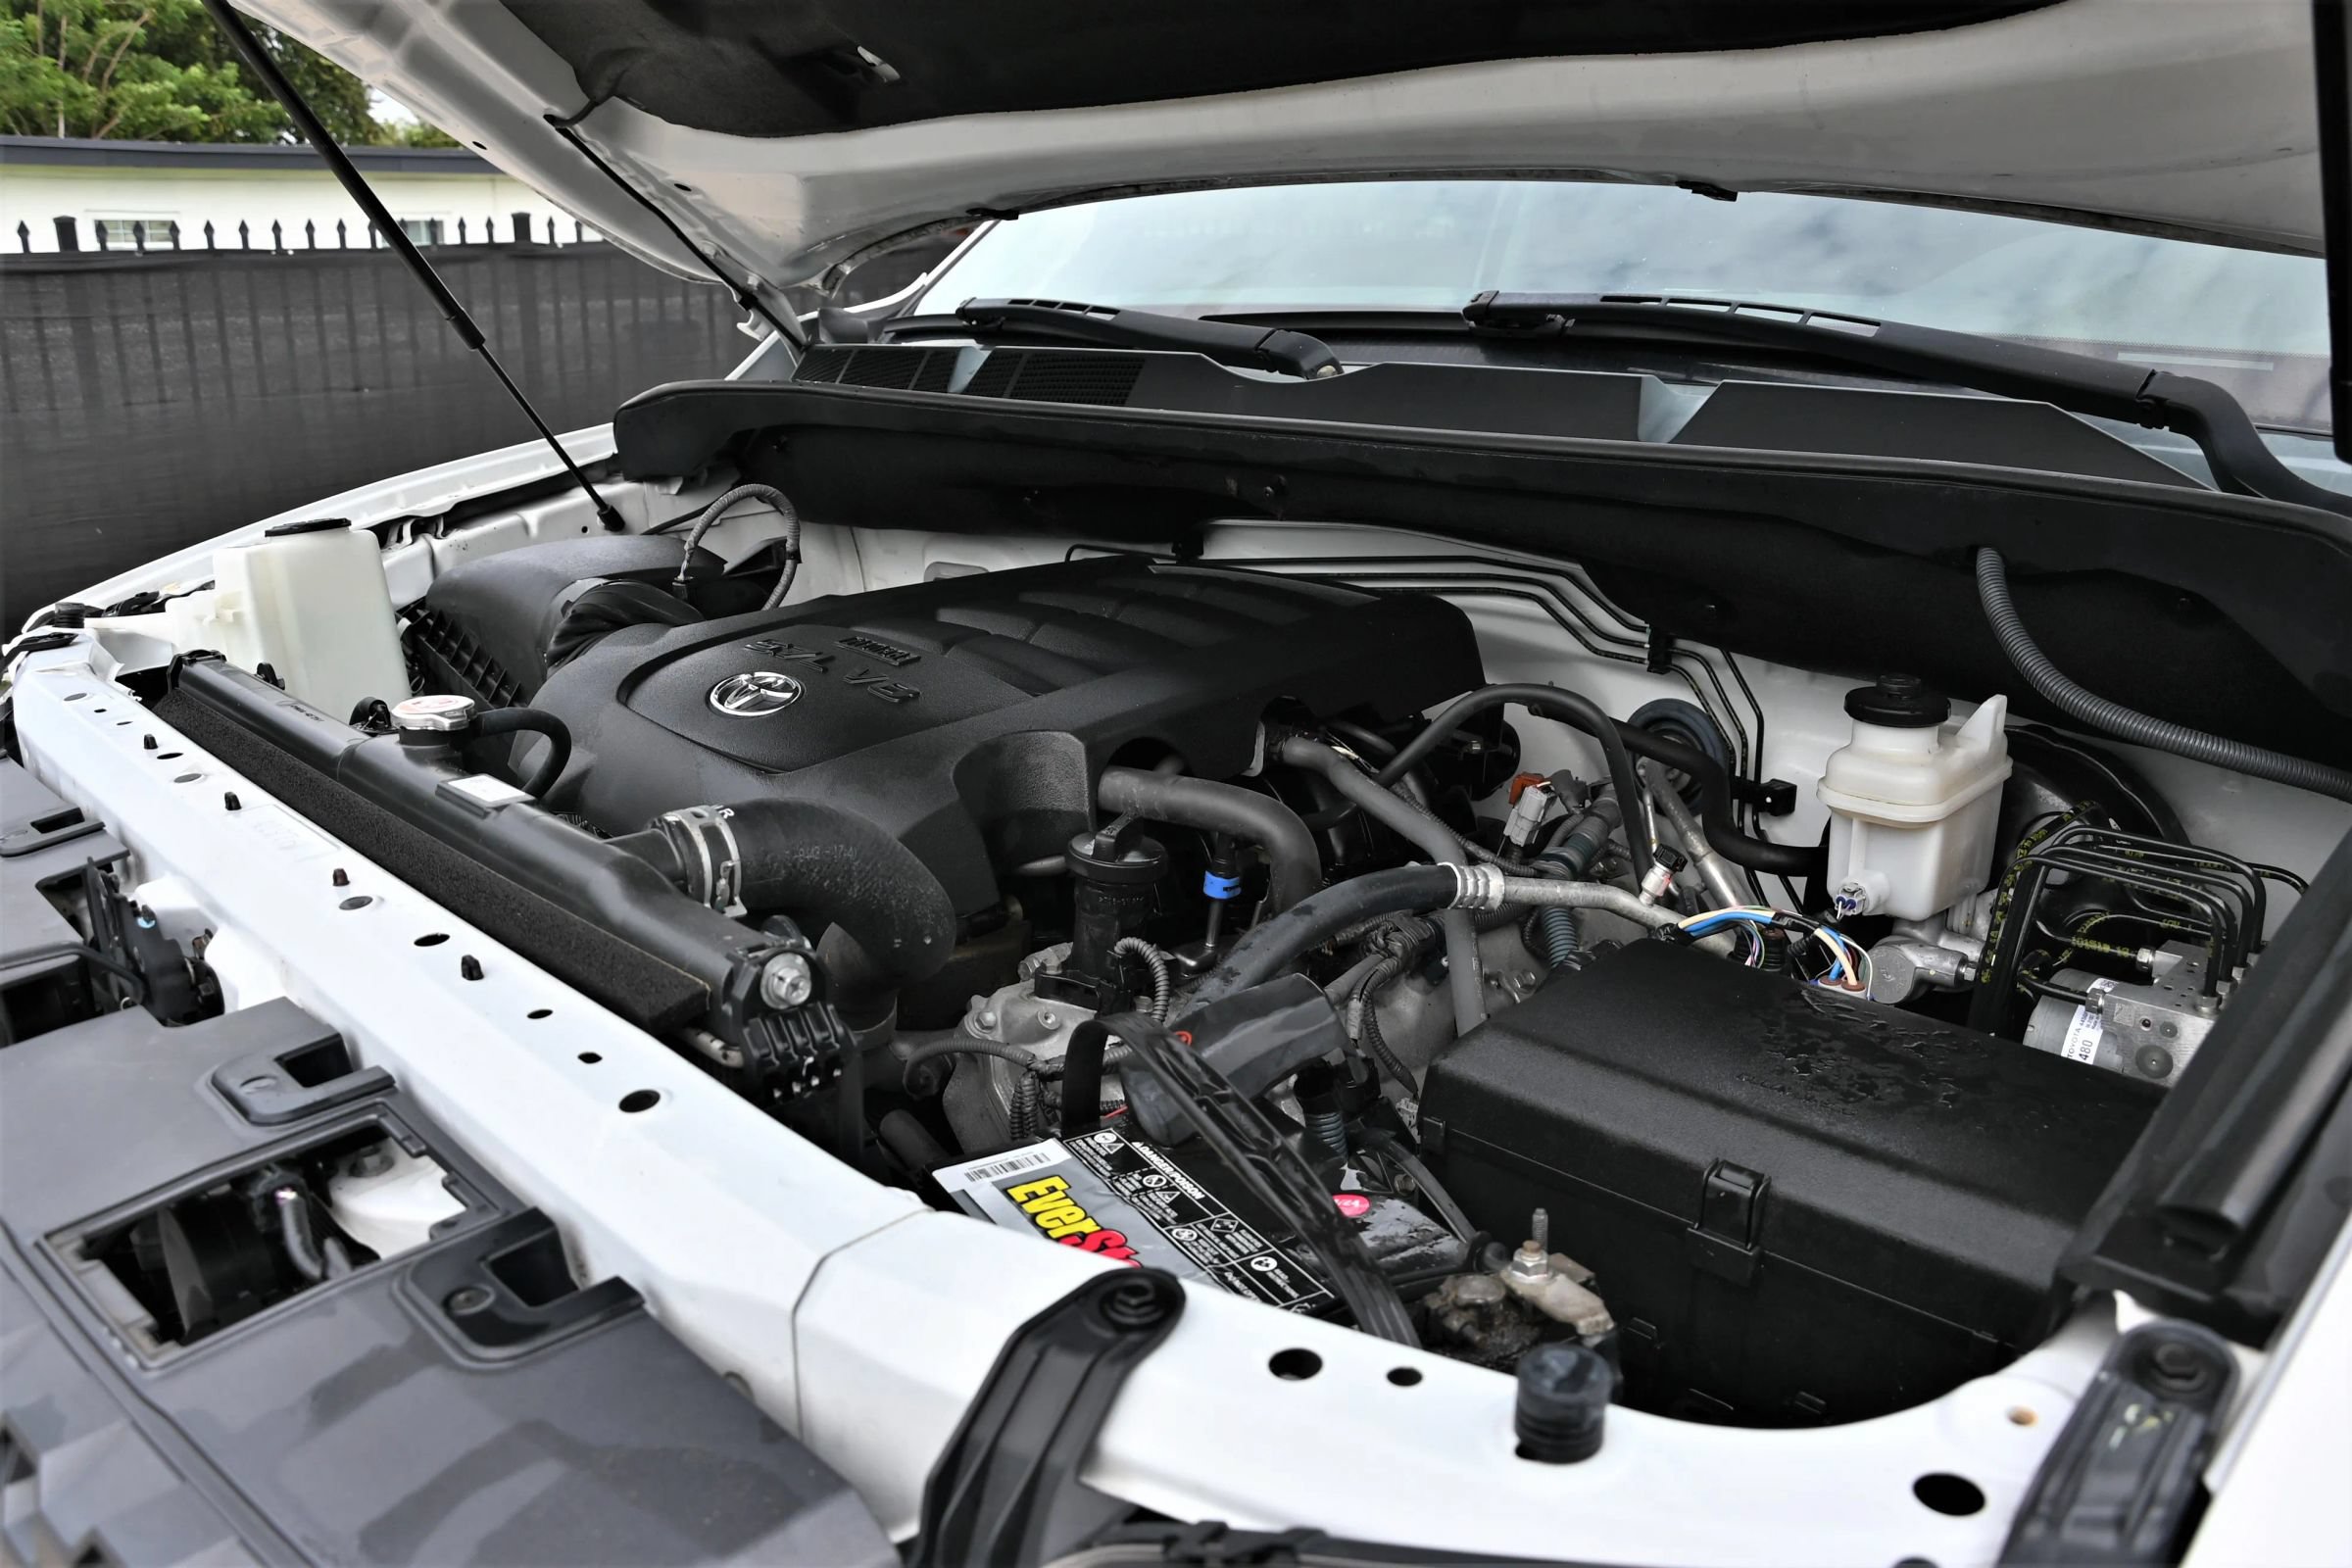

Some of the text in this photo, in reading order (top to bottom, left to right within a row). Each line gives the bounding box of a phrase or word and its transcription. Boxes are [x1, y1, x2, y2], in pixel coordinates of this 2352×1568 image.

[2068, 1027, 2082, 1058] TOYOTA
[2079, 1039, 2093, 1060] 480
[1140, 1144, 1205, 1200] DANGER/POISON
[1005, 1175, 1144, 1268] EverSt
